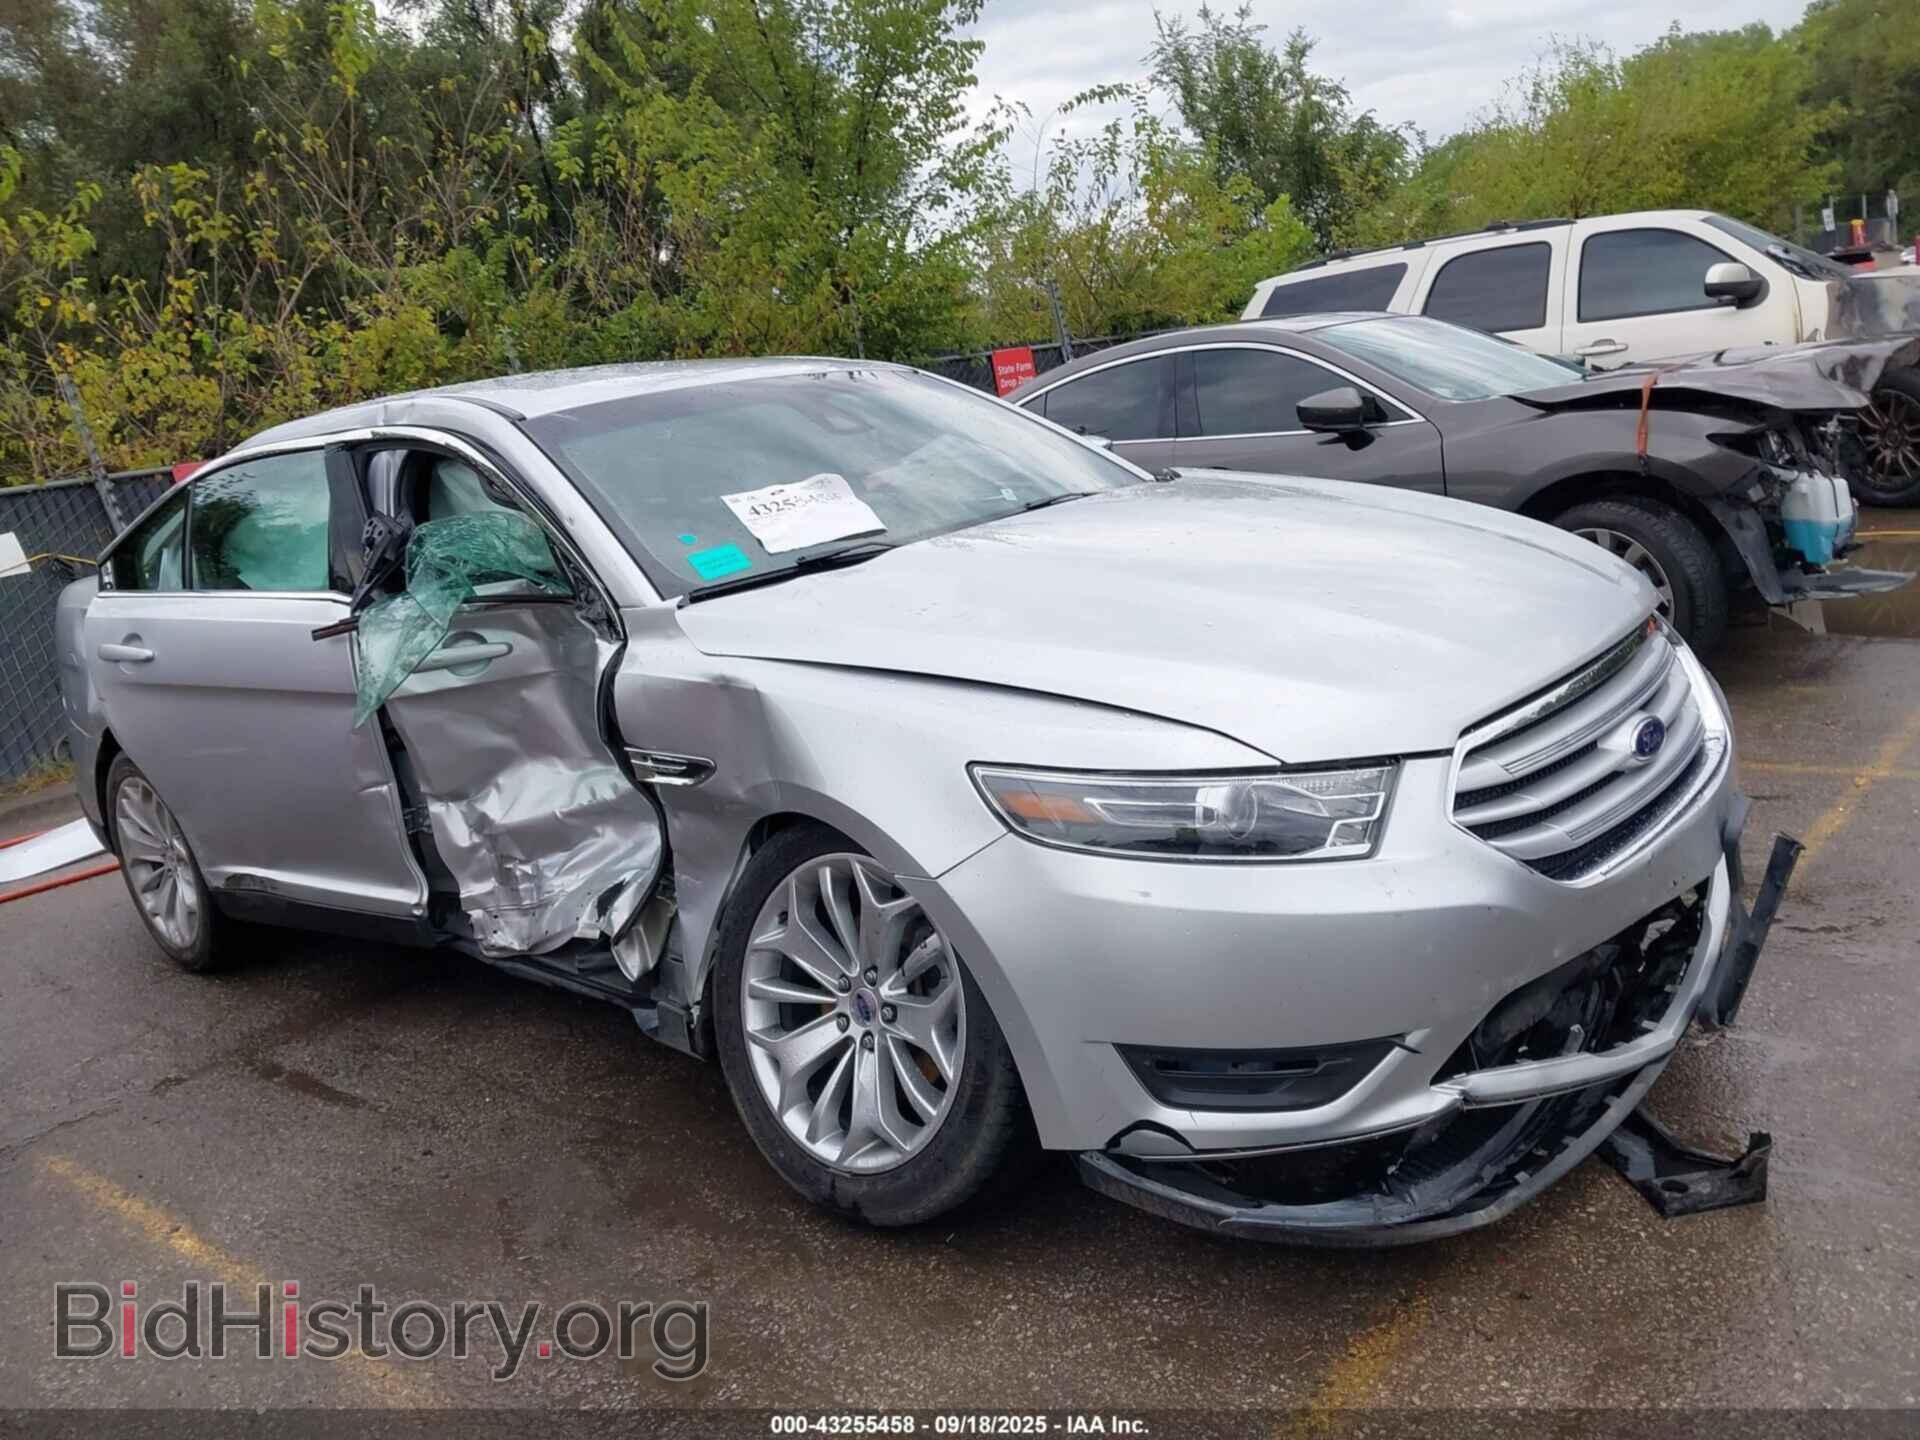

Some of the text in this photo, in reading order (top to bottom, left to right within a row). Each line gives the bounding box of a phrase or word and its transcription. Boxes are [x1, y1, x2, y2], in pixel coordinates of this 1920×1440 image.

[998, 362, 1032, 376] State Farm
[1000, 378, 1017, 390] Drop
